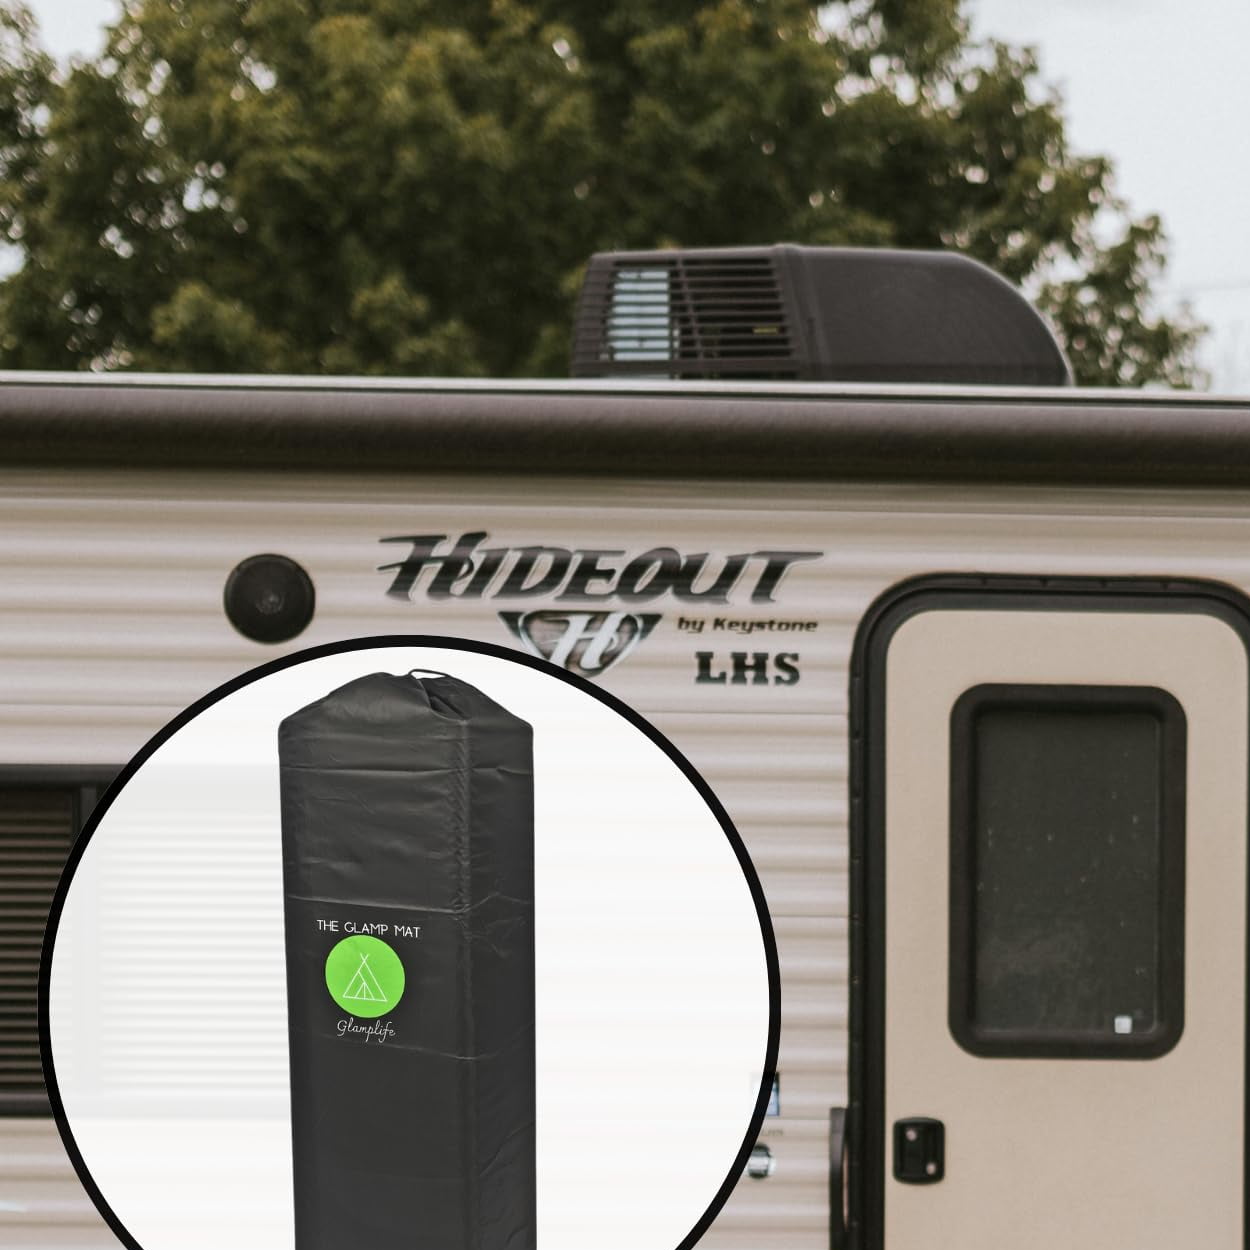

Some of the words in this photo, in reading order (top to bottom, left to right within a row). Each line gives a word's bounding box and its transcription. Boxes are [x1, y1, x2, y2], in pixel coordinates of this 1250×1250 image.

[377, 531, 824, 602] HIDEOUT
[677, 617, 704, 633] by
[713, 618, 818, 634] Keystone
[695, 651, 801, 685] LHS
[317, 919, 339, 932] THE
[344, 921, 389, 935] GLAMP
[394, 925, 421, 938] MAT
[337, 1017, 396, 1043] Glamplife
